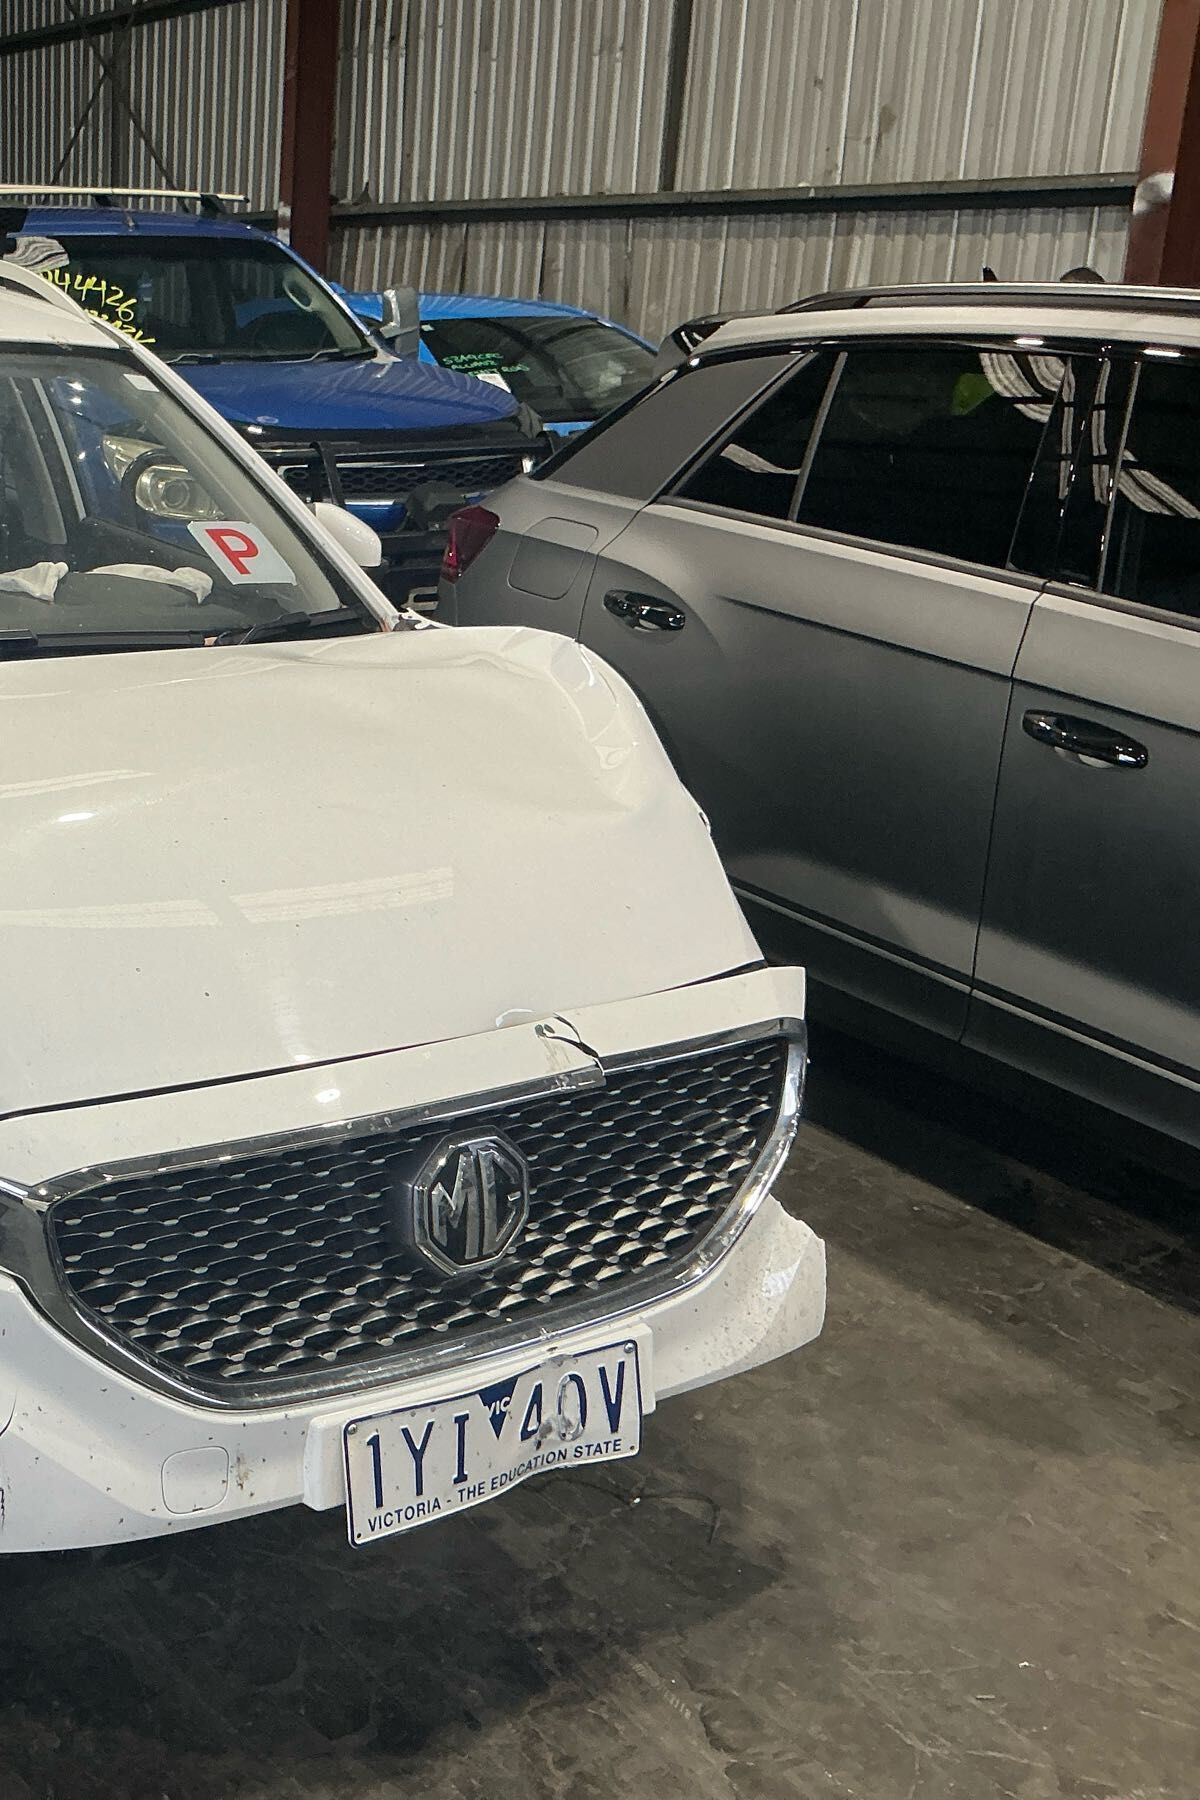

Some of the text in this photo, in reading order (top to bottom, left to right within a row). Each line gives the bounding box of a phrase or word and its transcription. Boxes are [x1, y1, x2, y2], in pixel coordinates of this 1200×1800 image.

[204, 528, 259, 575] P
[432, 1149, 521, 1260] MG
[488, 1396, 511, 1416] VIC
[368, 1497, 441, 1532] VICTORIA
[457, 1481, 486, 1502] THE
[490, 1448, 567, 1490] EDUCATION
[573, 1438, 622, 1459] STATE
